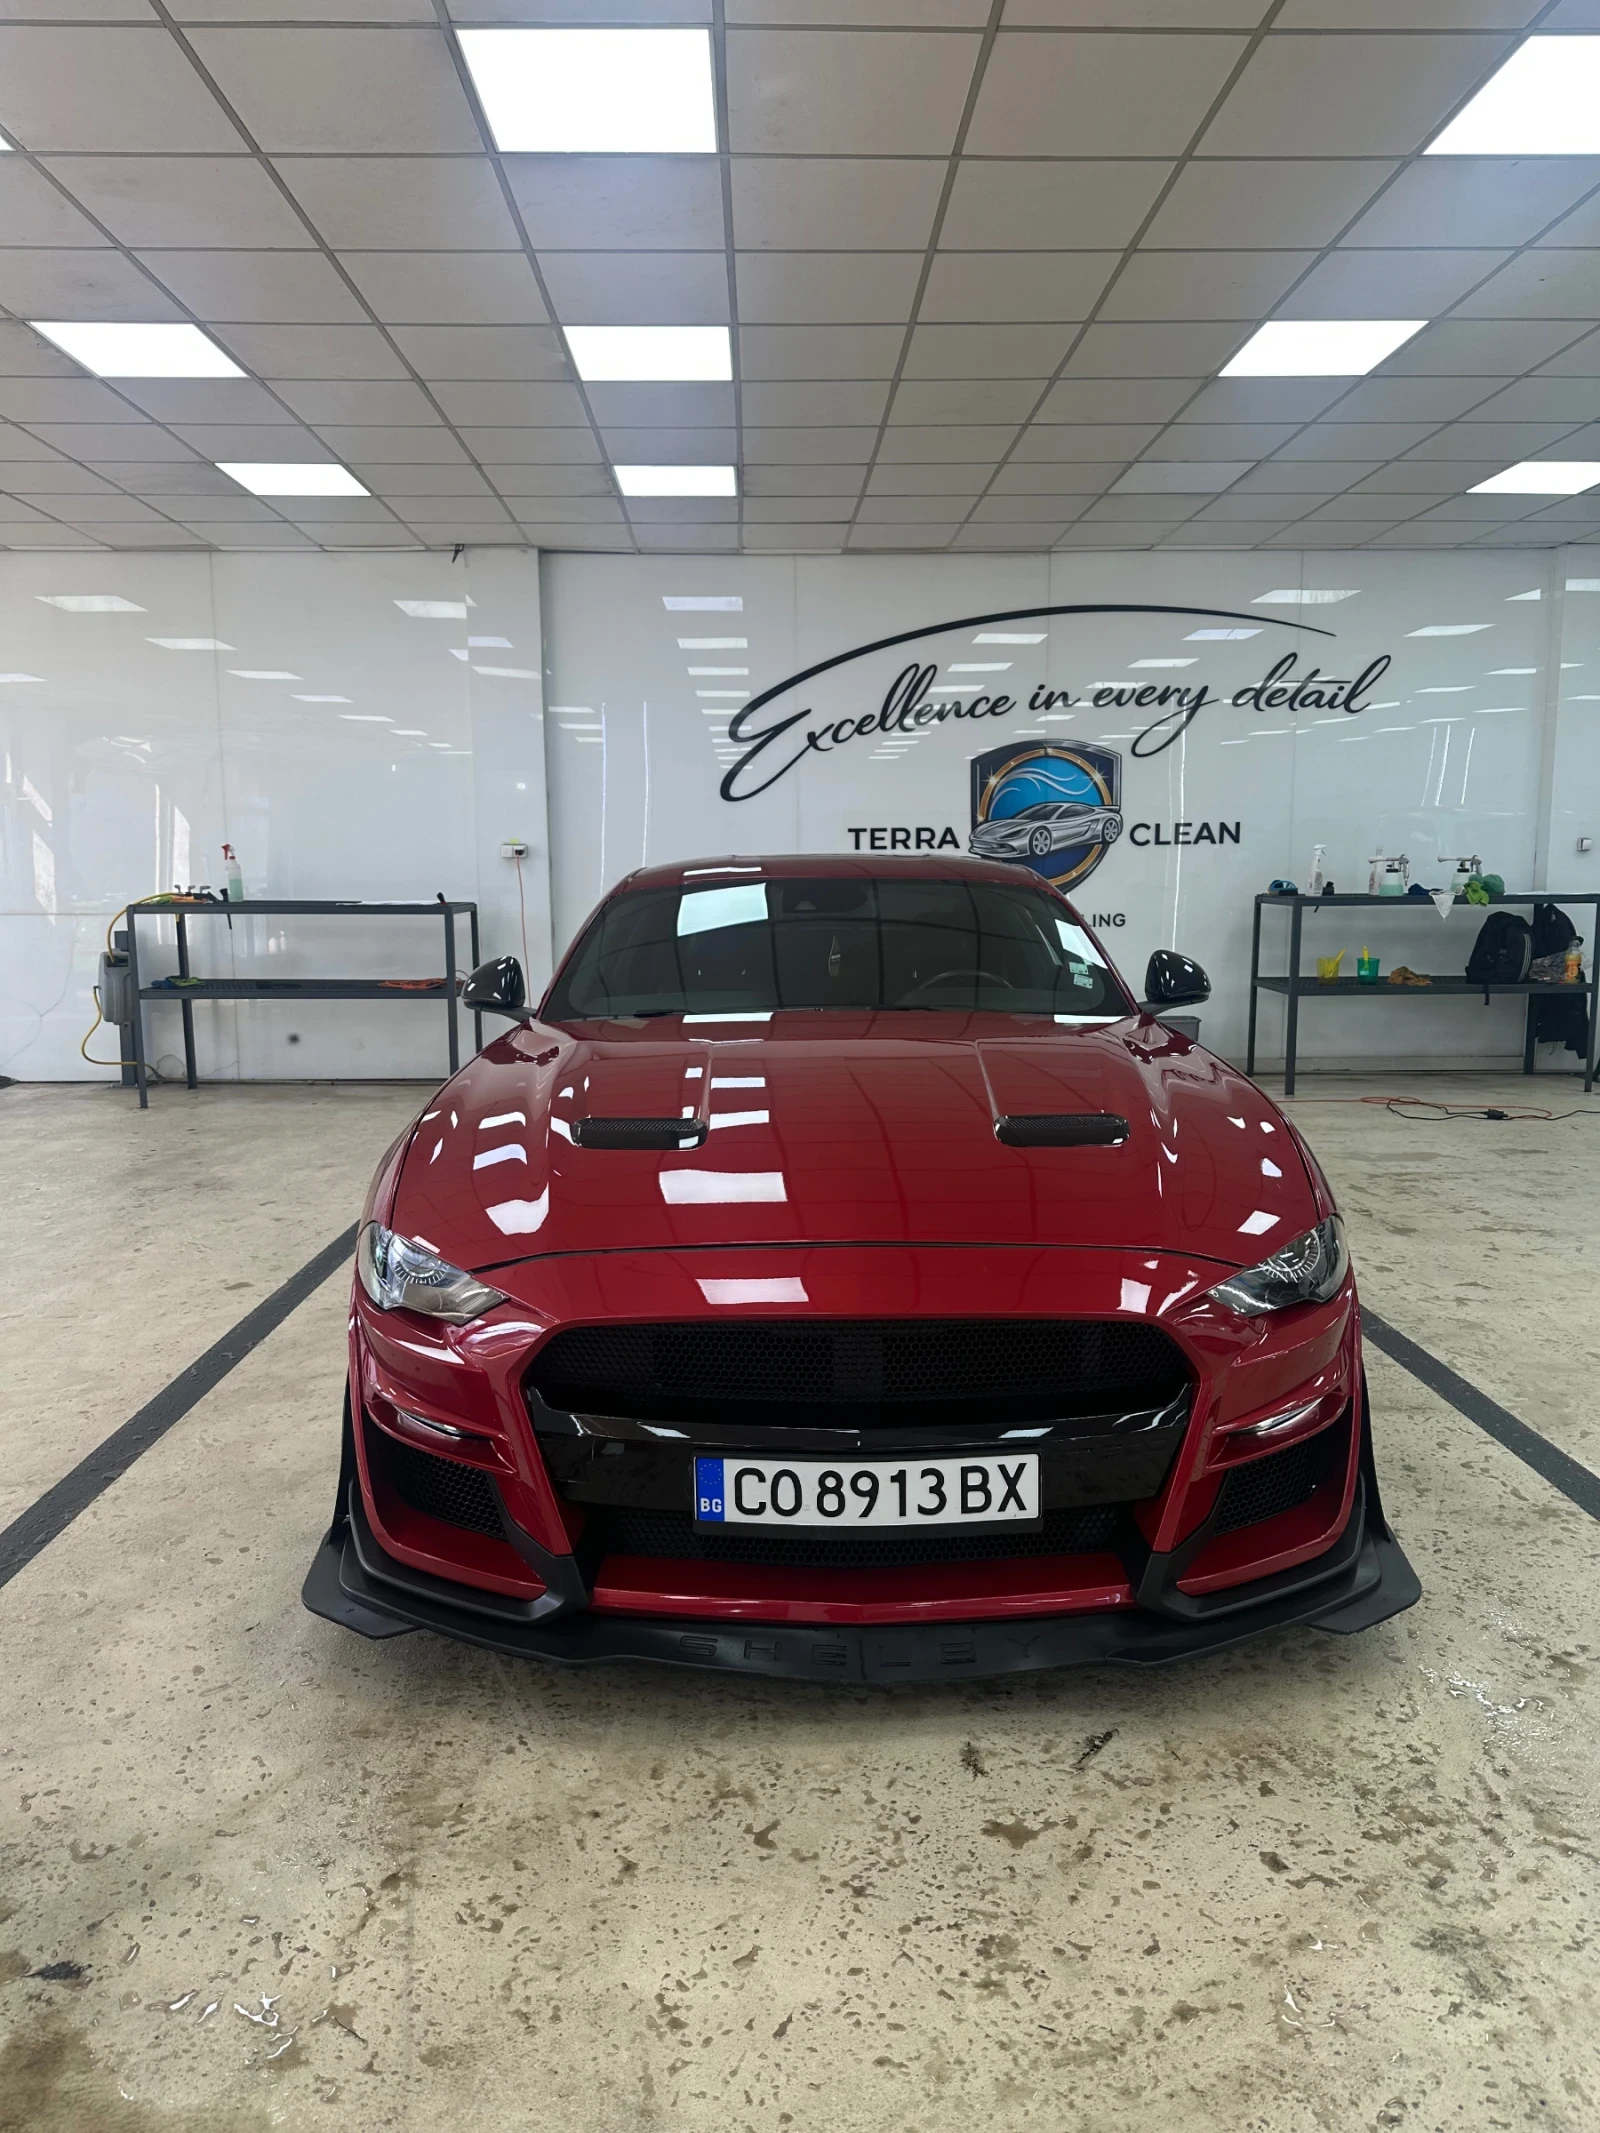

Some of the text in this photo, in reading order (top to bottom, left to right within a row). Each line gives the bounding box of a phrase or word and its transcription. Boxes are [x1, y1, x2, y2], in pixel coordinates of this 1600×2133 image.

[720, 652, 1391, 802] Excellence in every detail
[848, 822, 1241, 851] TERRA CLEAN
[1082, 913, 1126, 928] ING
[700, 1497, 722, 1513] BG
[816, 1467, 948, 1518] 8913
[960, 1462, 1027, 1514] BX
[679, 1634, 1041, 1667] SHELBY
